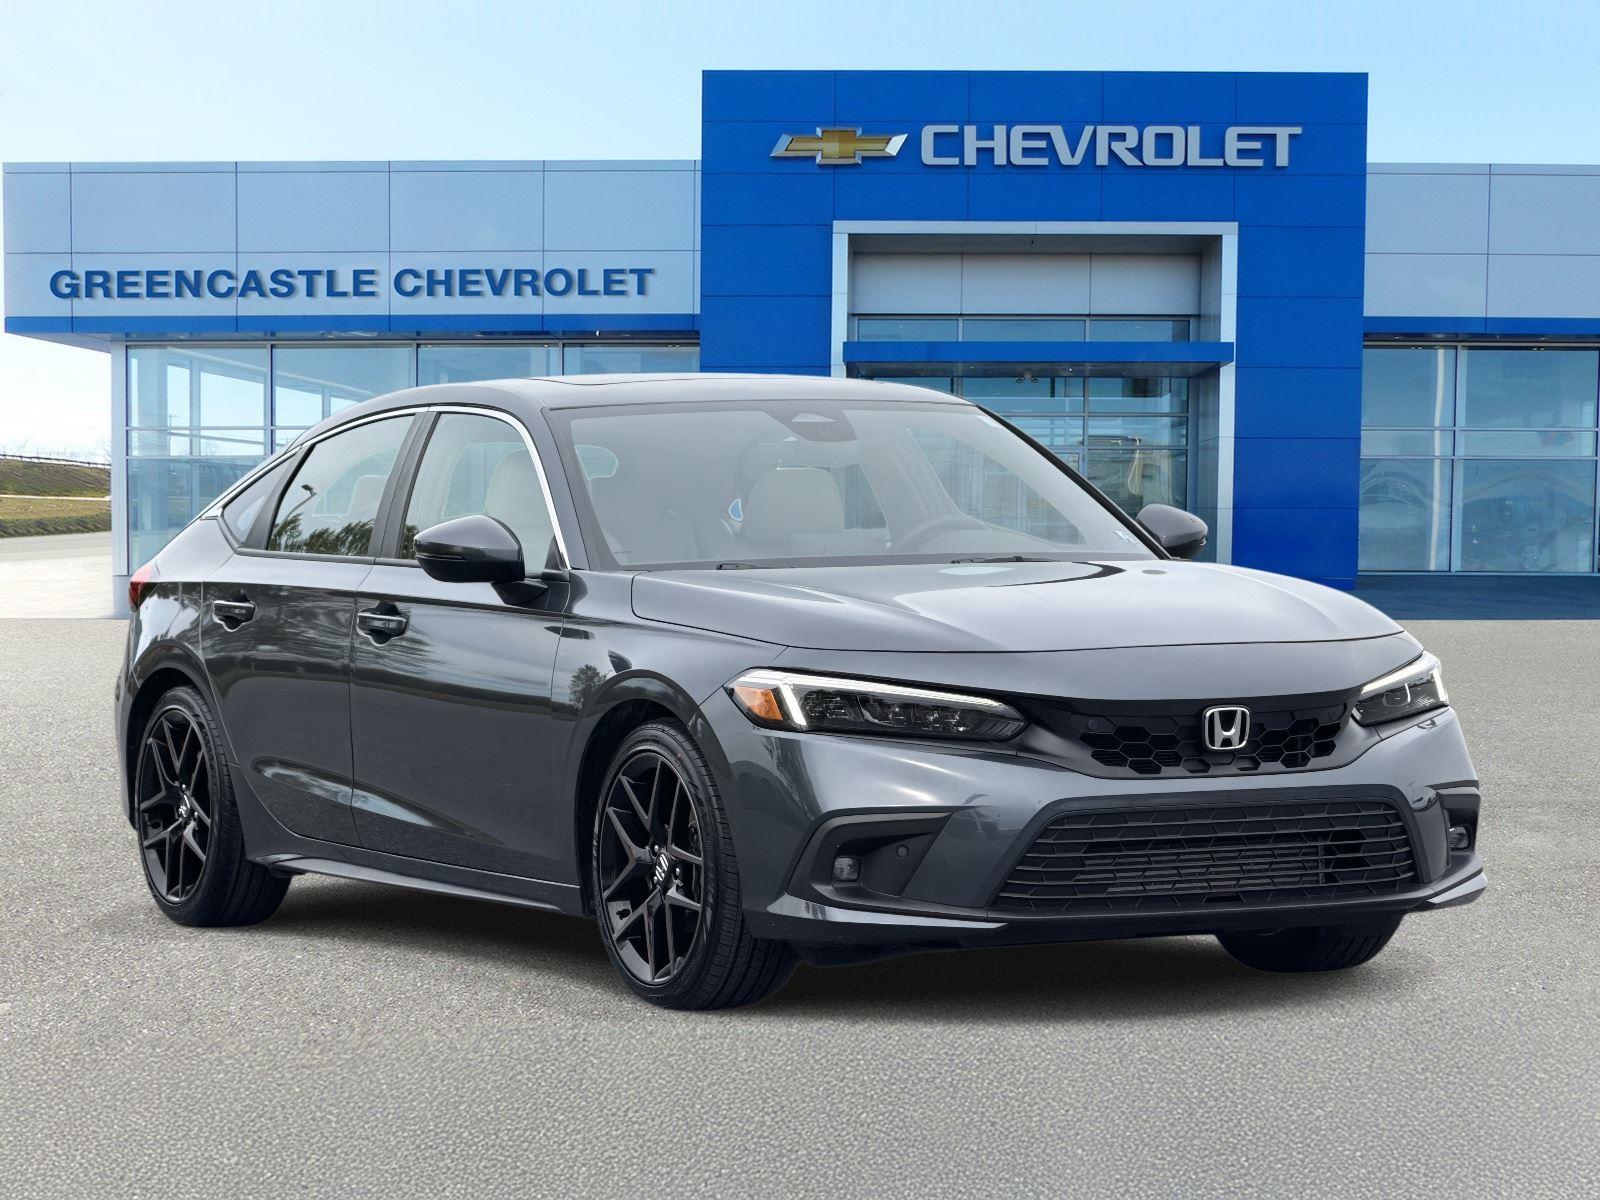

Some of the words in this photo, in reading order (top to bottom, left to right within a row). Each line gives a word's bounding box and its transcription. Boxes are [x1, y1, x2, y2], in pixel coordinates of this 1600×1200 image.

[921, 124, 1302, 167] CHEVROLET
[50, 269, 377, 299] GREENCASTLE
[394, 268, 655, 298] CHEVROLET
